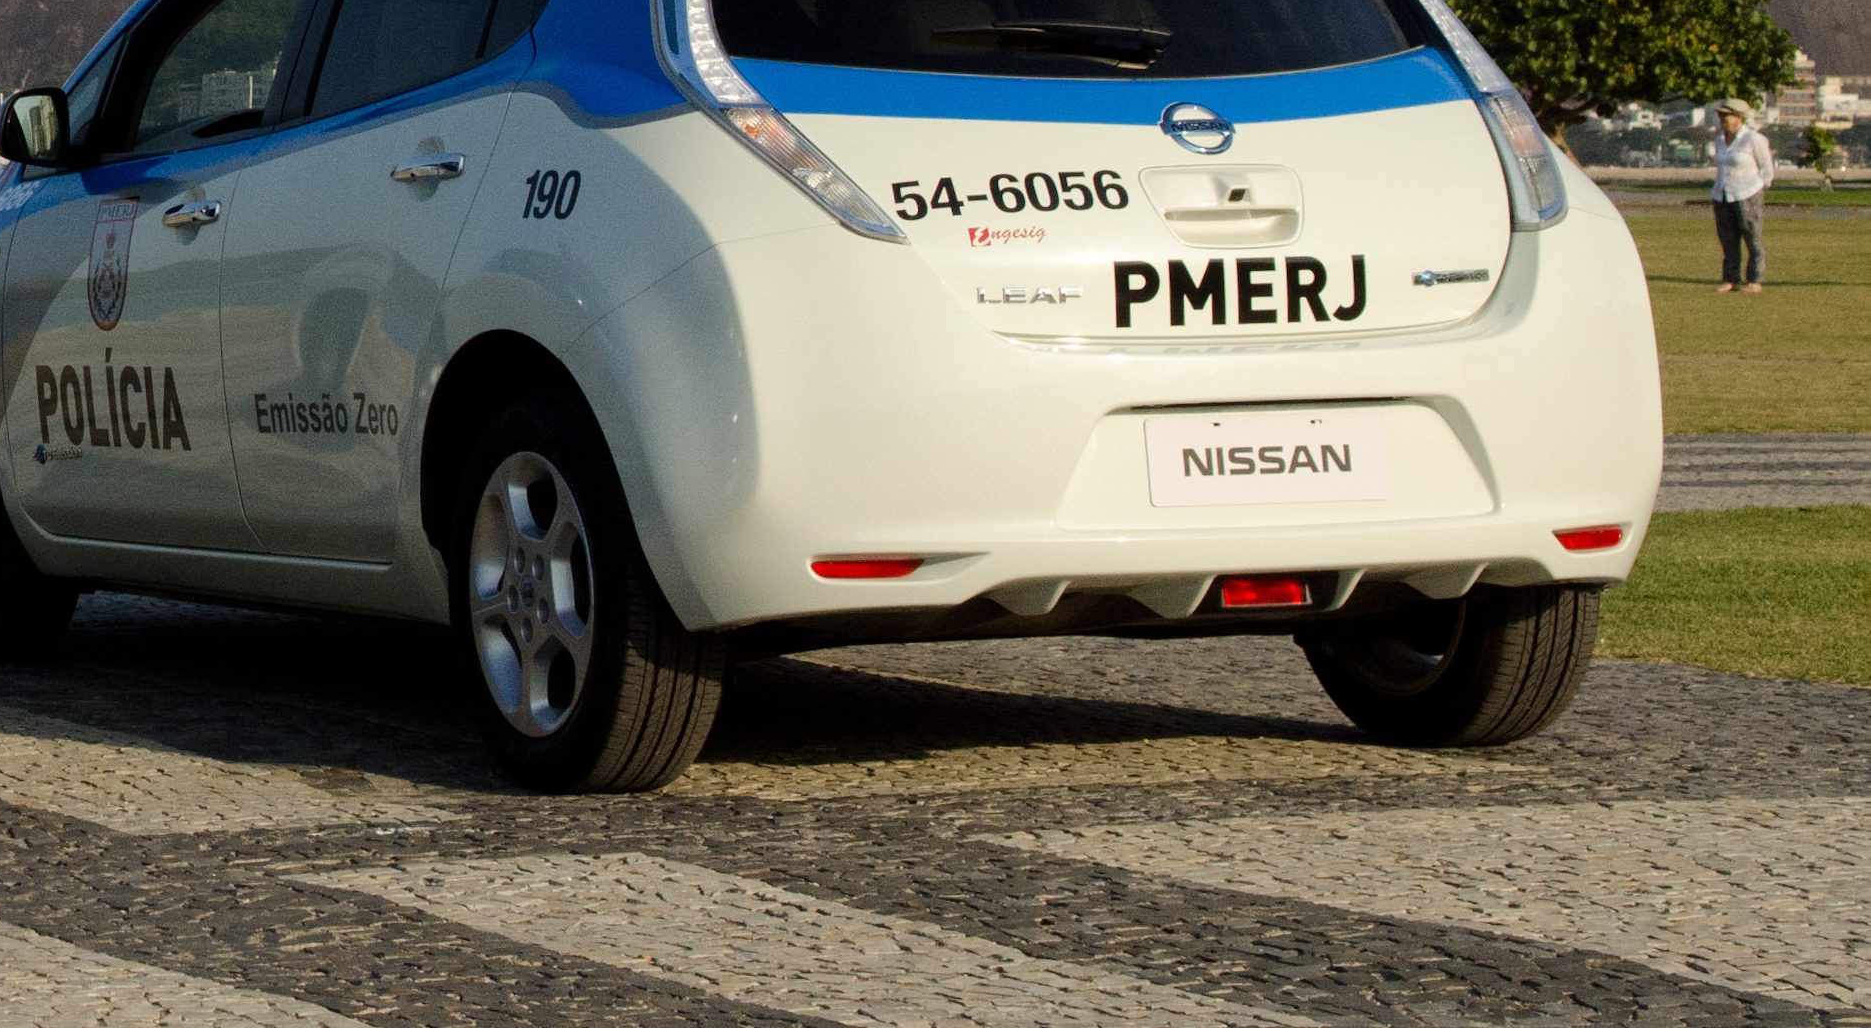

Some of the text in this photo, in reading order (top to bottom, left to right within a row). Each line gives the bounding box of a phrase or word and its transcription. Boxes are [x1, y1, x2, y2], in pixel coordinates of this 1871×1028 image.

[522, 169, 581, 220] 190
[891, 169, 1129, 221] 54-6056
[976, 287, 1085, 304] LEAF
[1114, 254, 1367, 328] PMERJ
[35, 347, 192, 451] POLÍCIA
[254, 392, 398, 437] Emissão Zero
[1182, 444, 1352, 477] NISSAN
